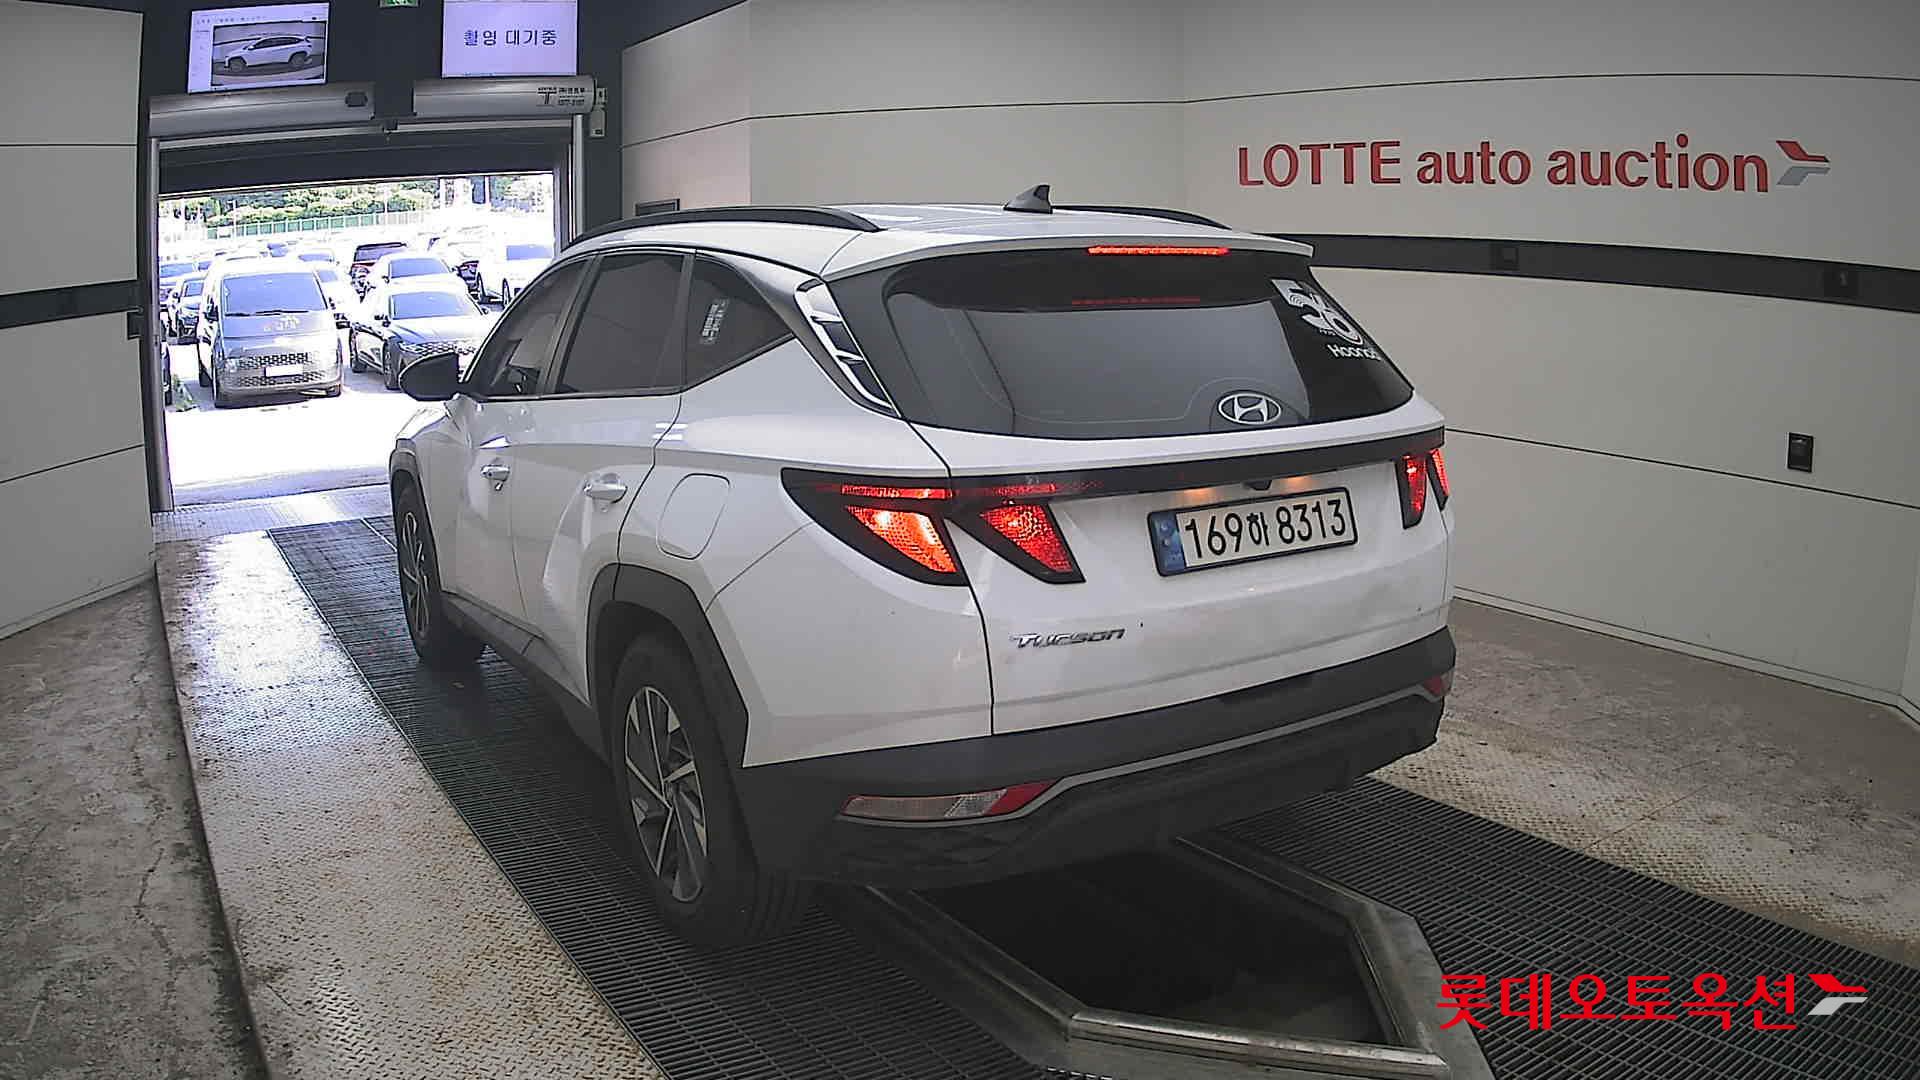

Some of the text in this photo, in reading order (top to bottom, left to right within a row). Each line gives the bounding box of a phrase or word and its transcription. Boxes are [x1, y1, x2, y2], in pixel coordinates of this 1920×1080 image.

[504, 29, 558, 46] 대기중
[1239, 133, 1769, 193] LOTTE auto auction
[1185, 499, 1346, 558] 169하 8313
